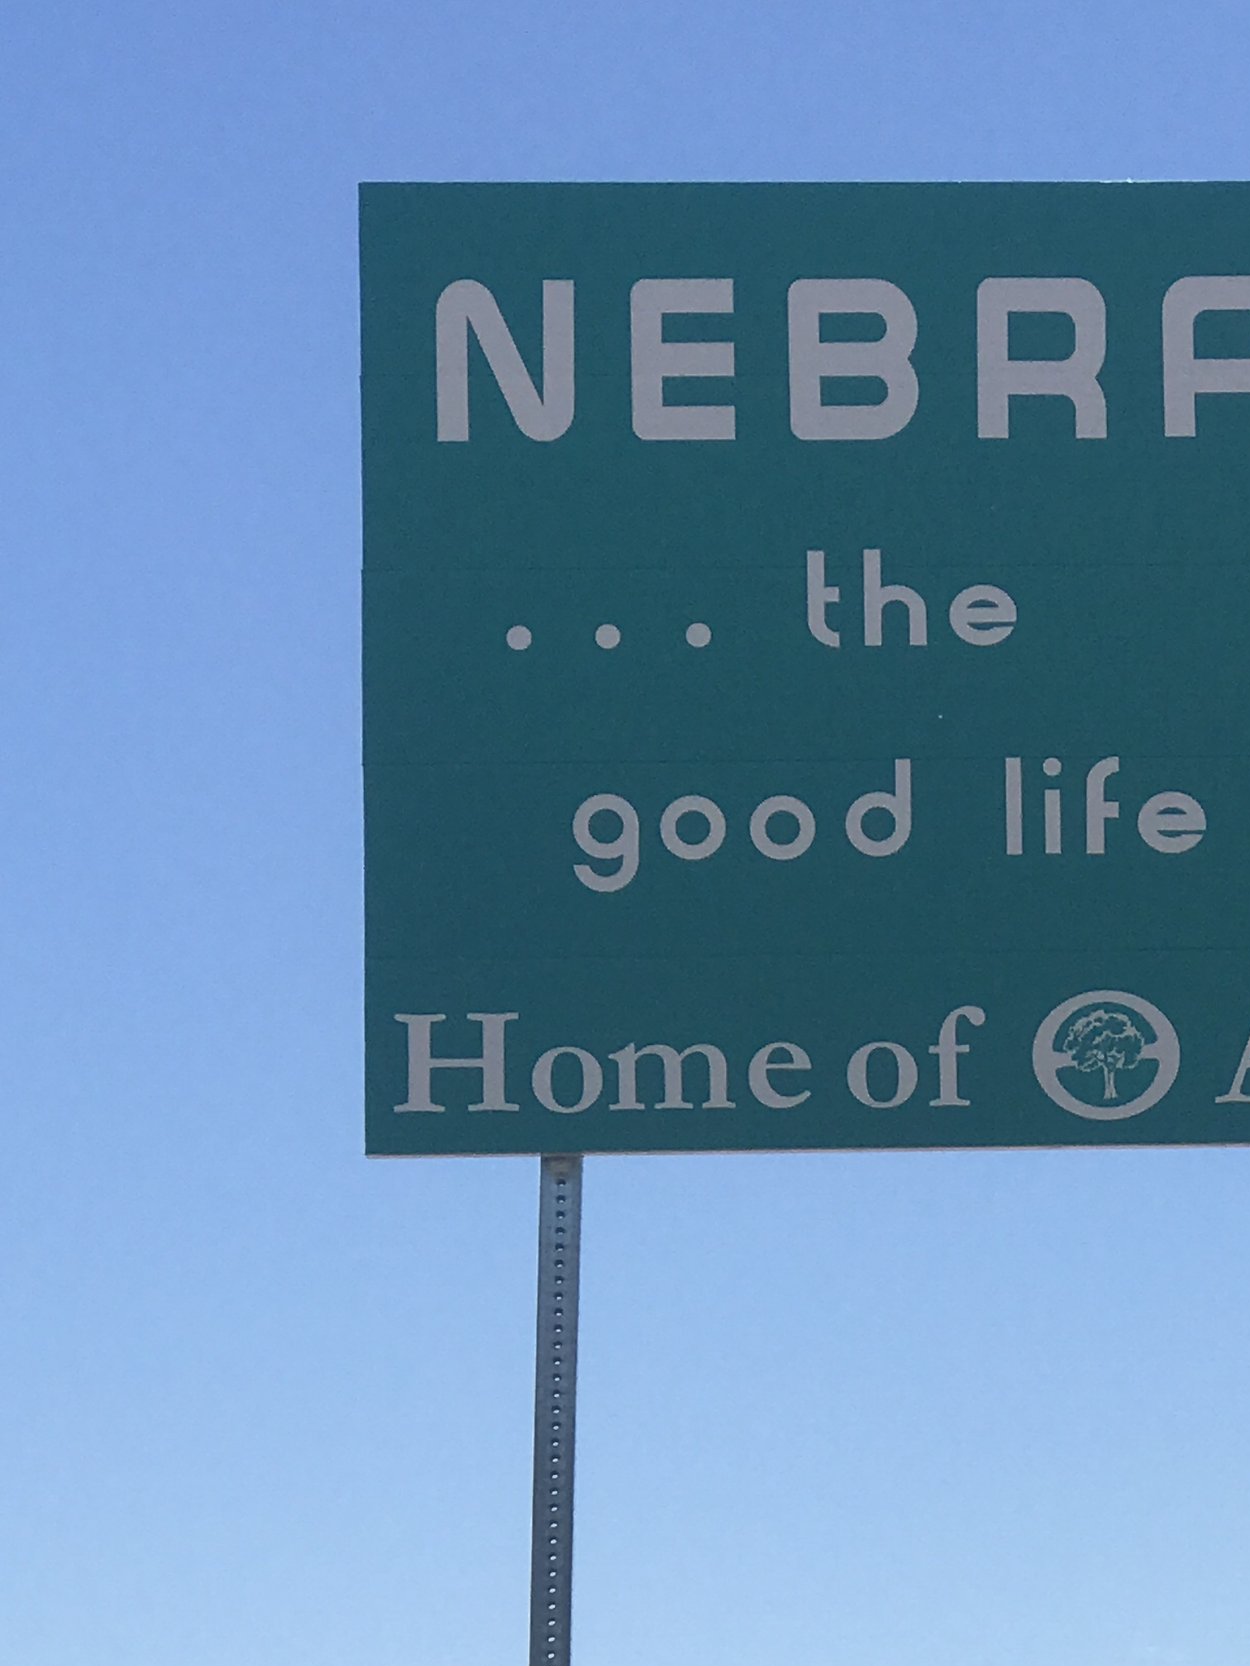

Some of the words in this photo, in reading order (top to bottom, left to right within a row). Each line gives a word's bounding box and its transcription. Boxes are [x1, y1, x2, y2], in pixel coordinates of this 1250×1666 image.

[807, 549, 1016, 647] the
[573, 759, 911, 892] good
[1006, 757, 1206, 855] life
[394, 1008, 812, 1113] Home
[848, 1005, 985, 1109] of
